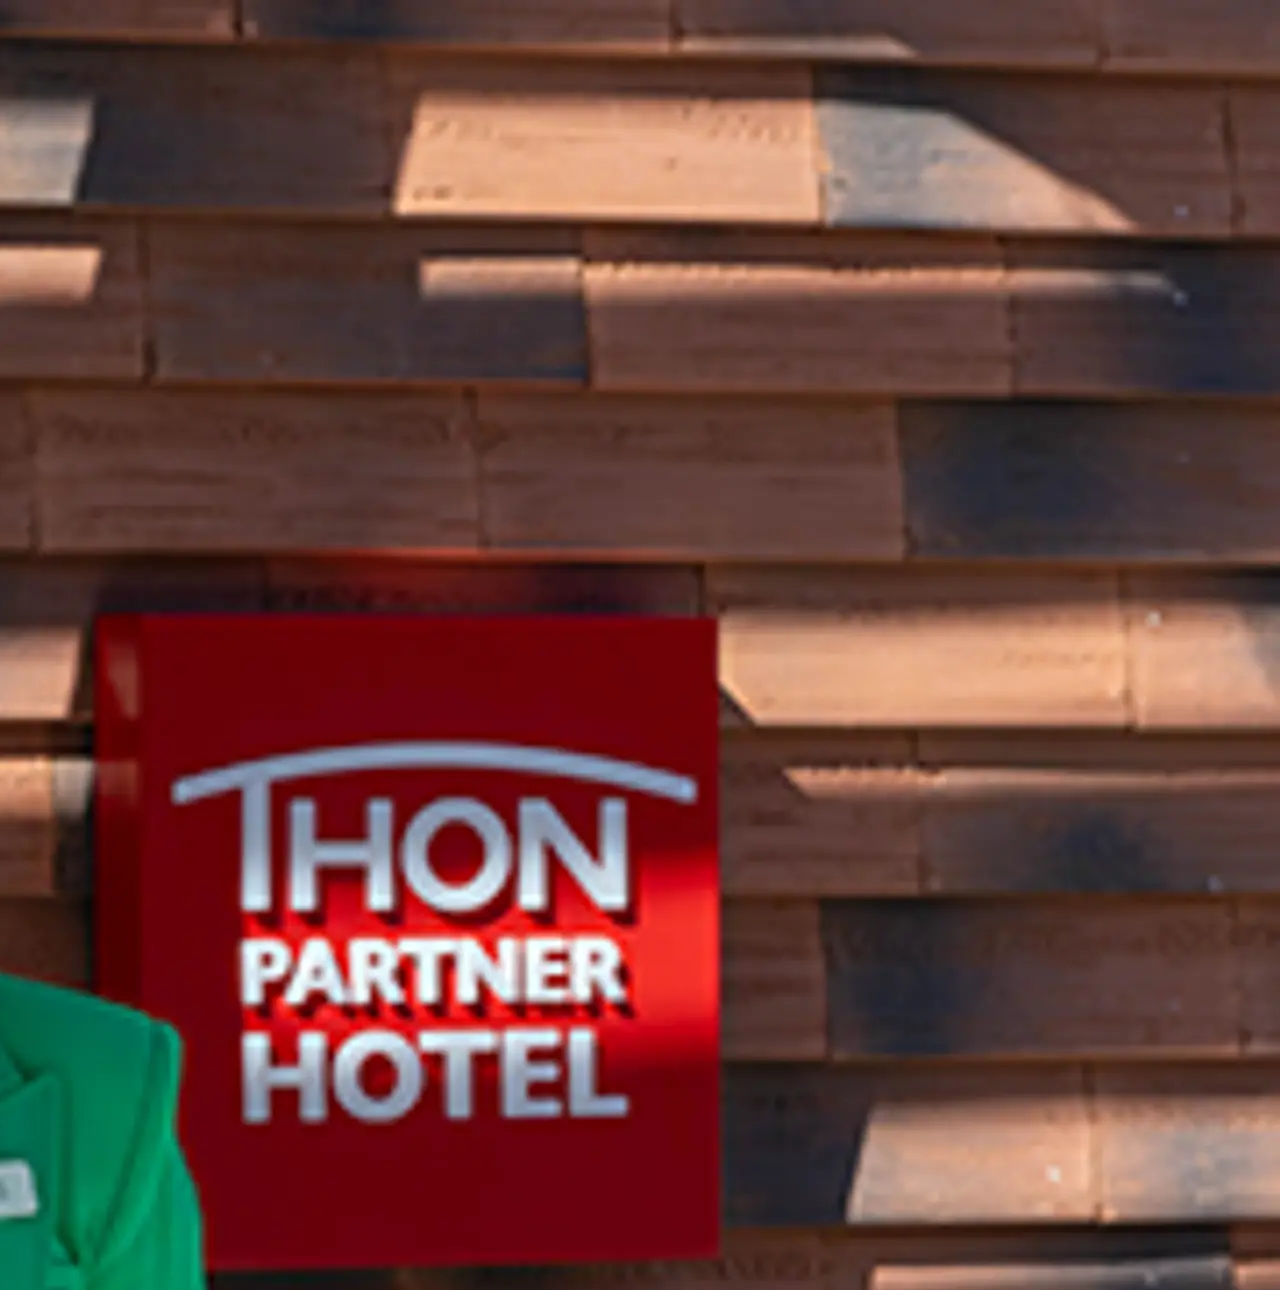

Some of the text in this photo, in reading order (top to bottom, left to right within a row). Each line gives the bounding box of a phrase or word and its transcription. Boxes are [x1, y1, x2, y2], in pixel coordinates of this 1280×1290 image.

[171, 740, 697, 914] THON
[240, 936, 626, 1005] PARTNER
[241, 1027, 630, 1125] HOTEL
